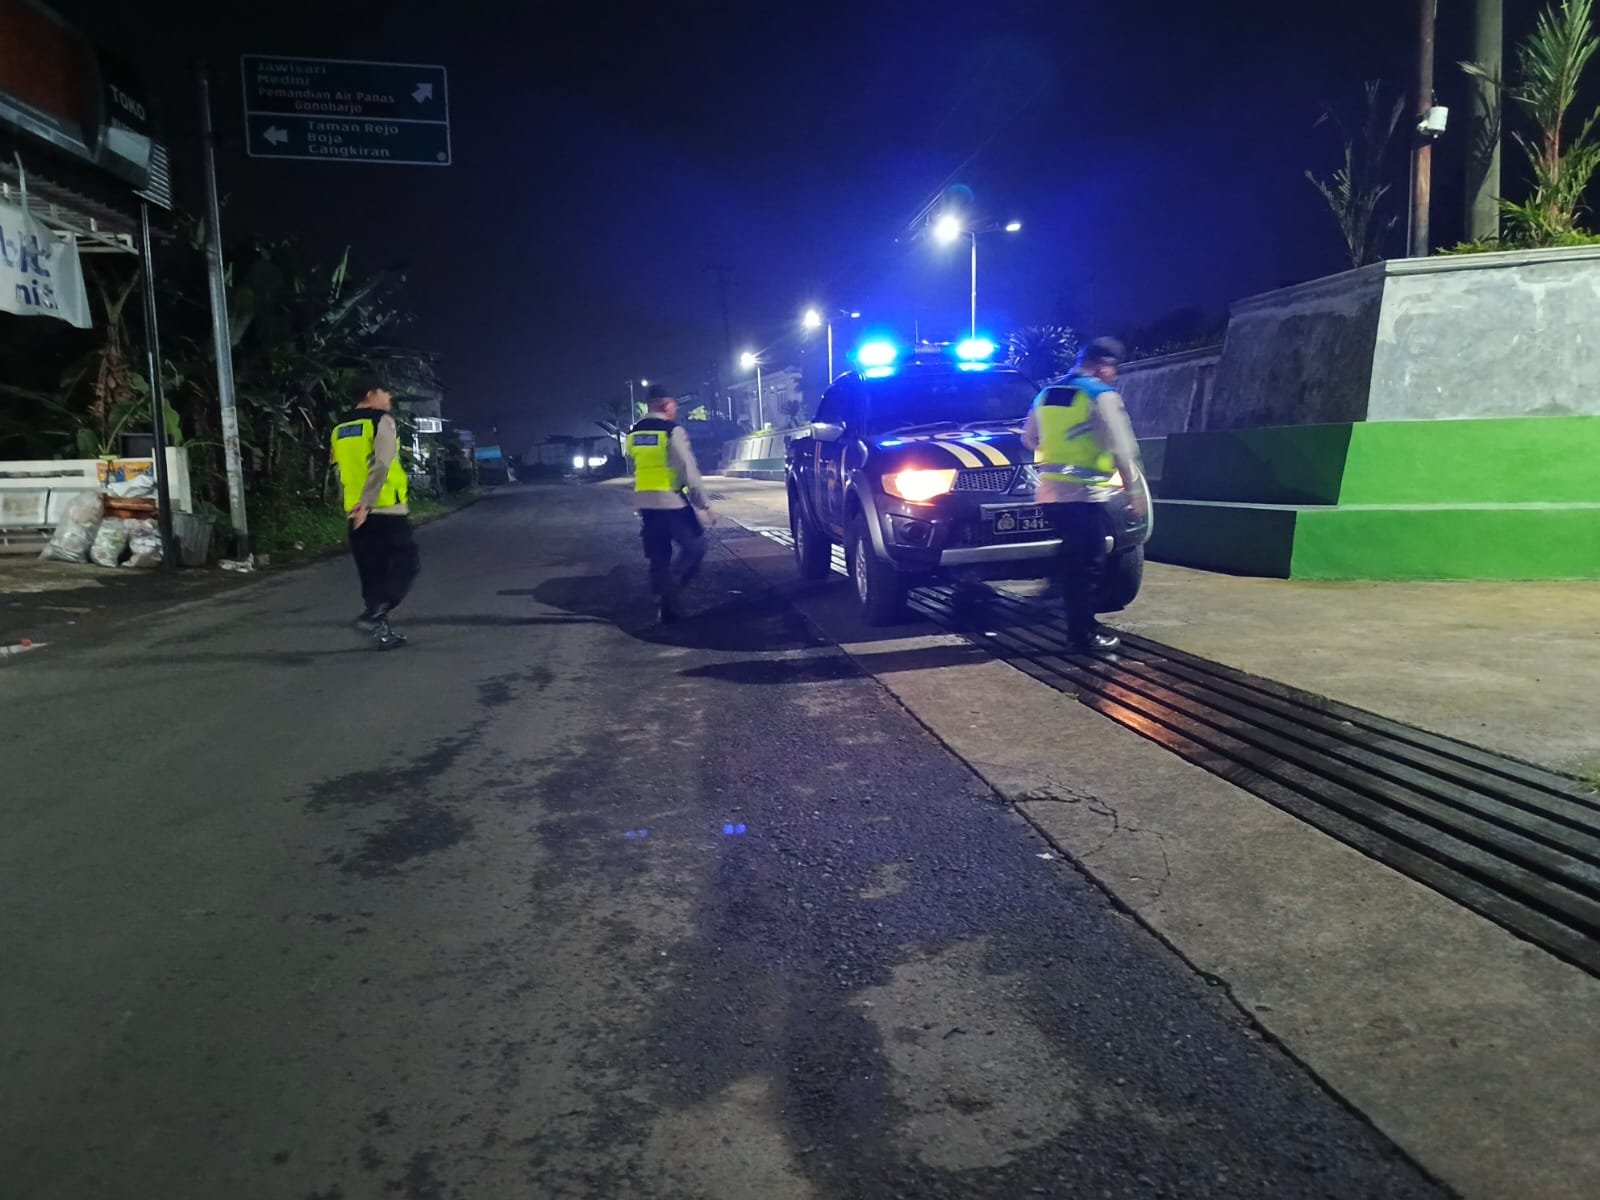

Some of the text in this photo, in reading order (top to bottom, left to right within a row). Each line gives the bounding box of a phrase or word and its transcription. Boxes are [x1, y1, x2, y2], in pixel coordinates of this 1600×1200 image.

[257, 75, 310, 86] Medini
[109, 83, 147, 120] TOKO
[258, 88, 395, 104] Pemandian Air Panas
[308, 121, 399, 136] Taman Rejo
[307, 132, 342, 145] Boja
[308, 144, 390, 158] Cangkiran
